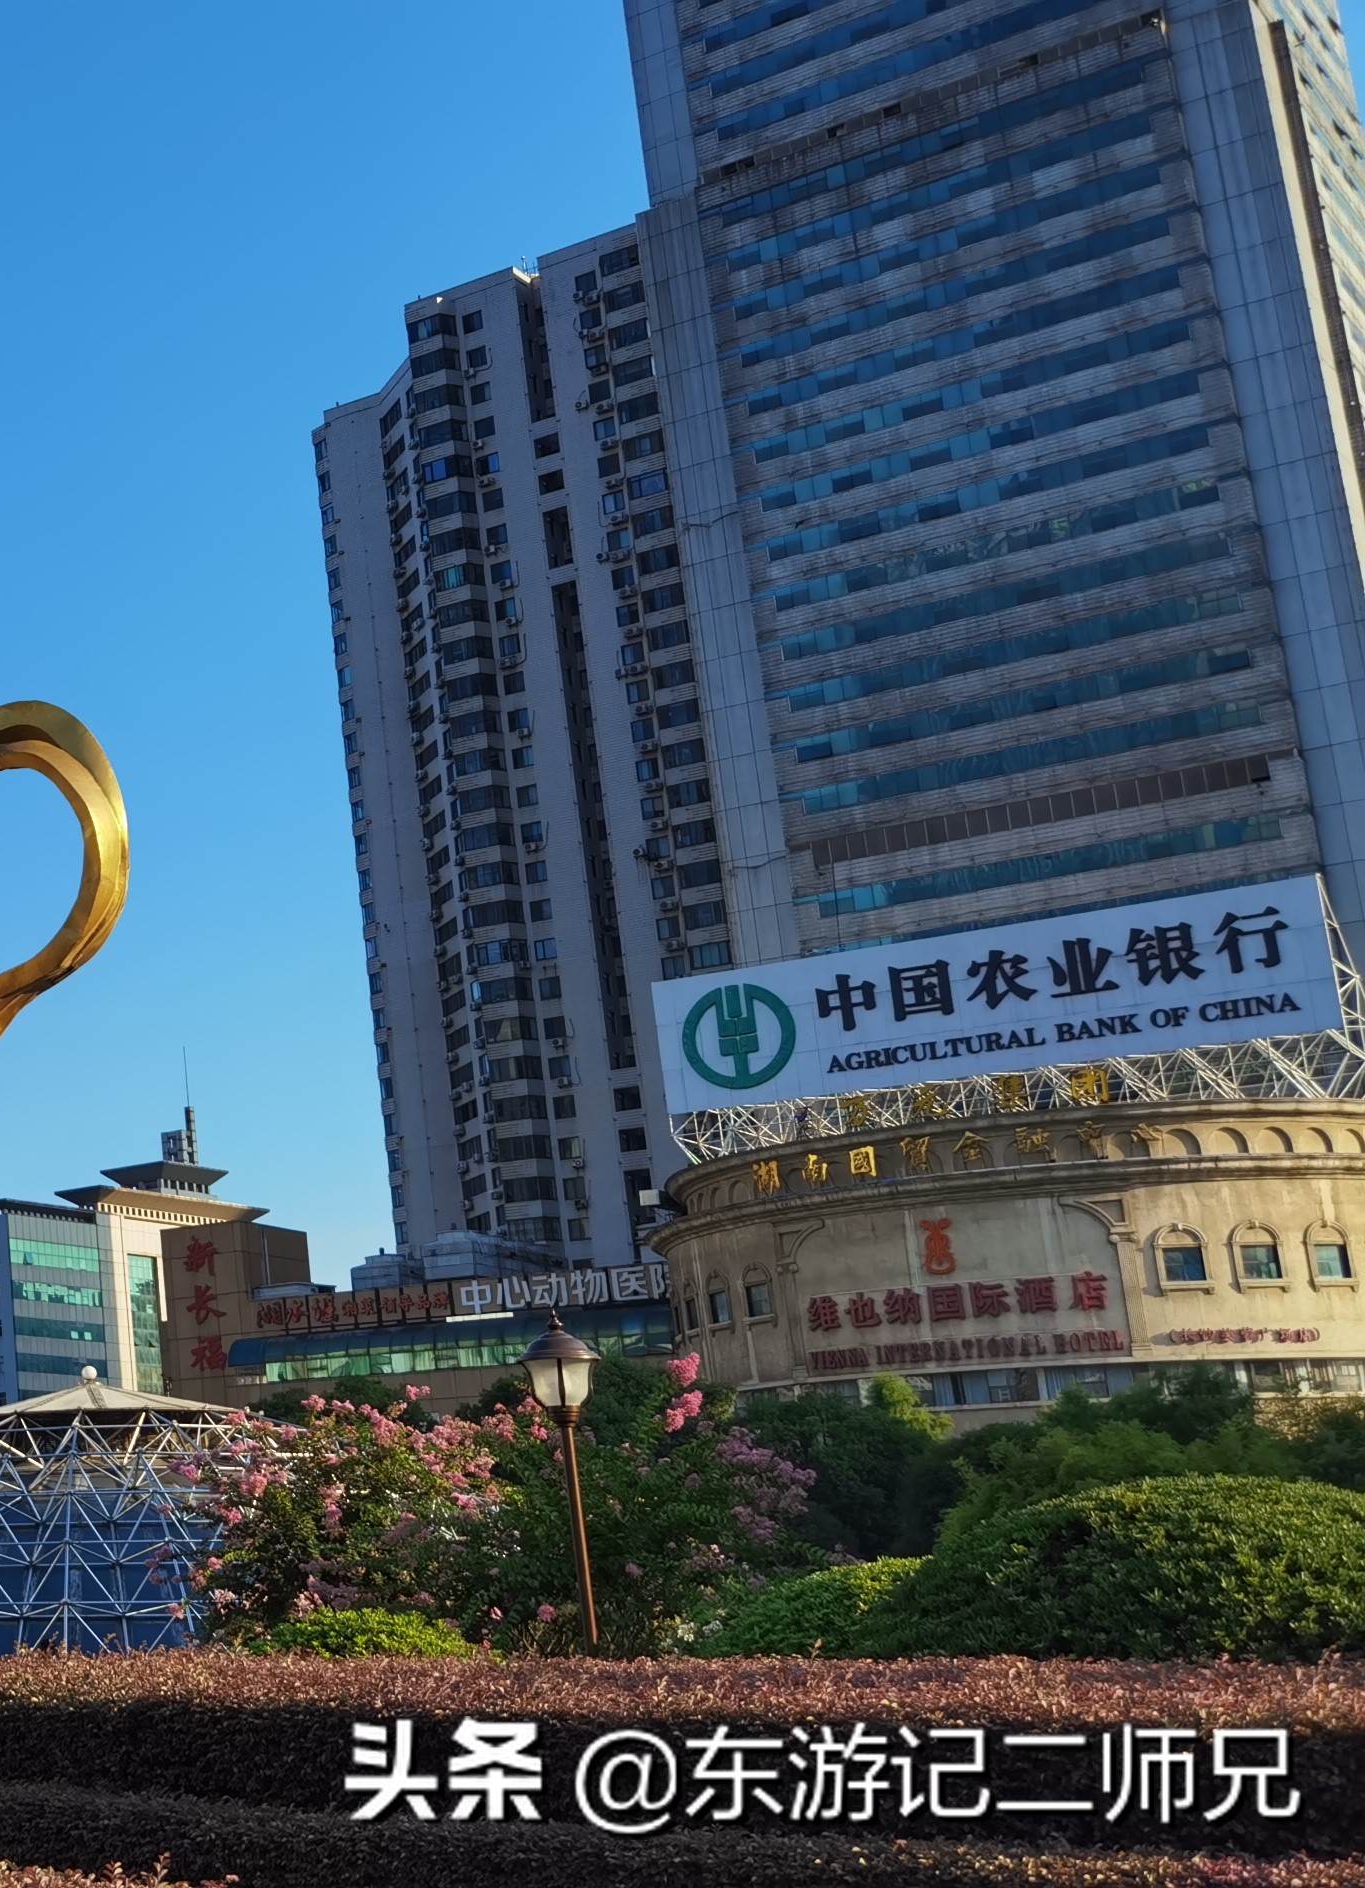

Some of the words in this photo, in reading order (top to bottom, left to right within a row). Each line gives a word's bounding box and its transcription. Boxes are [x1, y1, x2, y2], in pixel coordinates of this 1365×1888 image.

[815, 906, 1289, 1032] 中国农业银行
[827, 1026, 1046, 1075] AGRICULTURAL
[1055, 1013, 1142, 1043] BANK
[1149, 1006, 1189, 1028] OF
[1199, 992, 1301, 1023] CHINA
[183, 1234, 227, 1372] 新长福
[807, 1271, 1107, 1331] 维也纳国际酒店
[808, 1347, 870, 1371] VIENNA
[875, 1334, 1047, 1366] INTERNATIONAL
[1053, 1329, 1125, 1355] HOTEL
